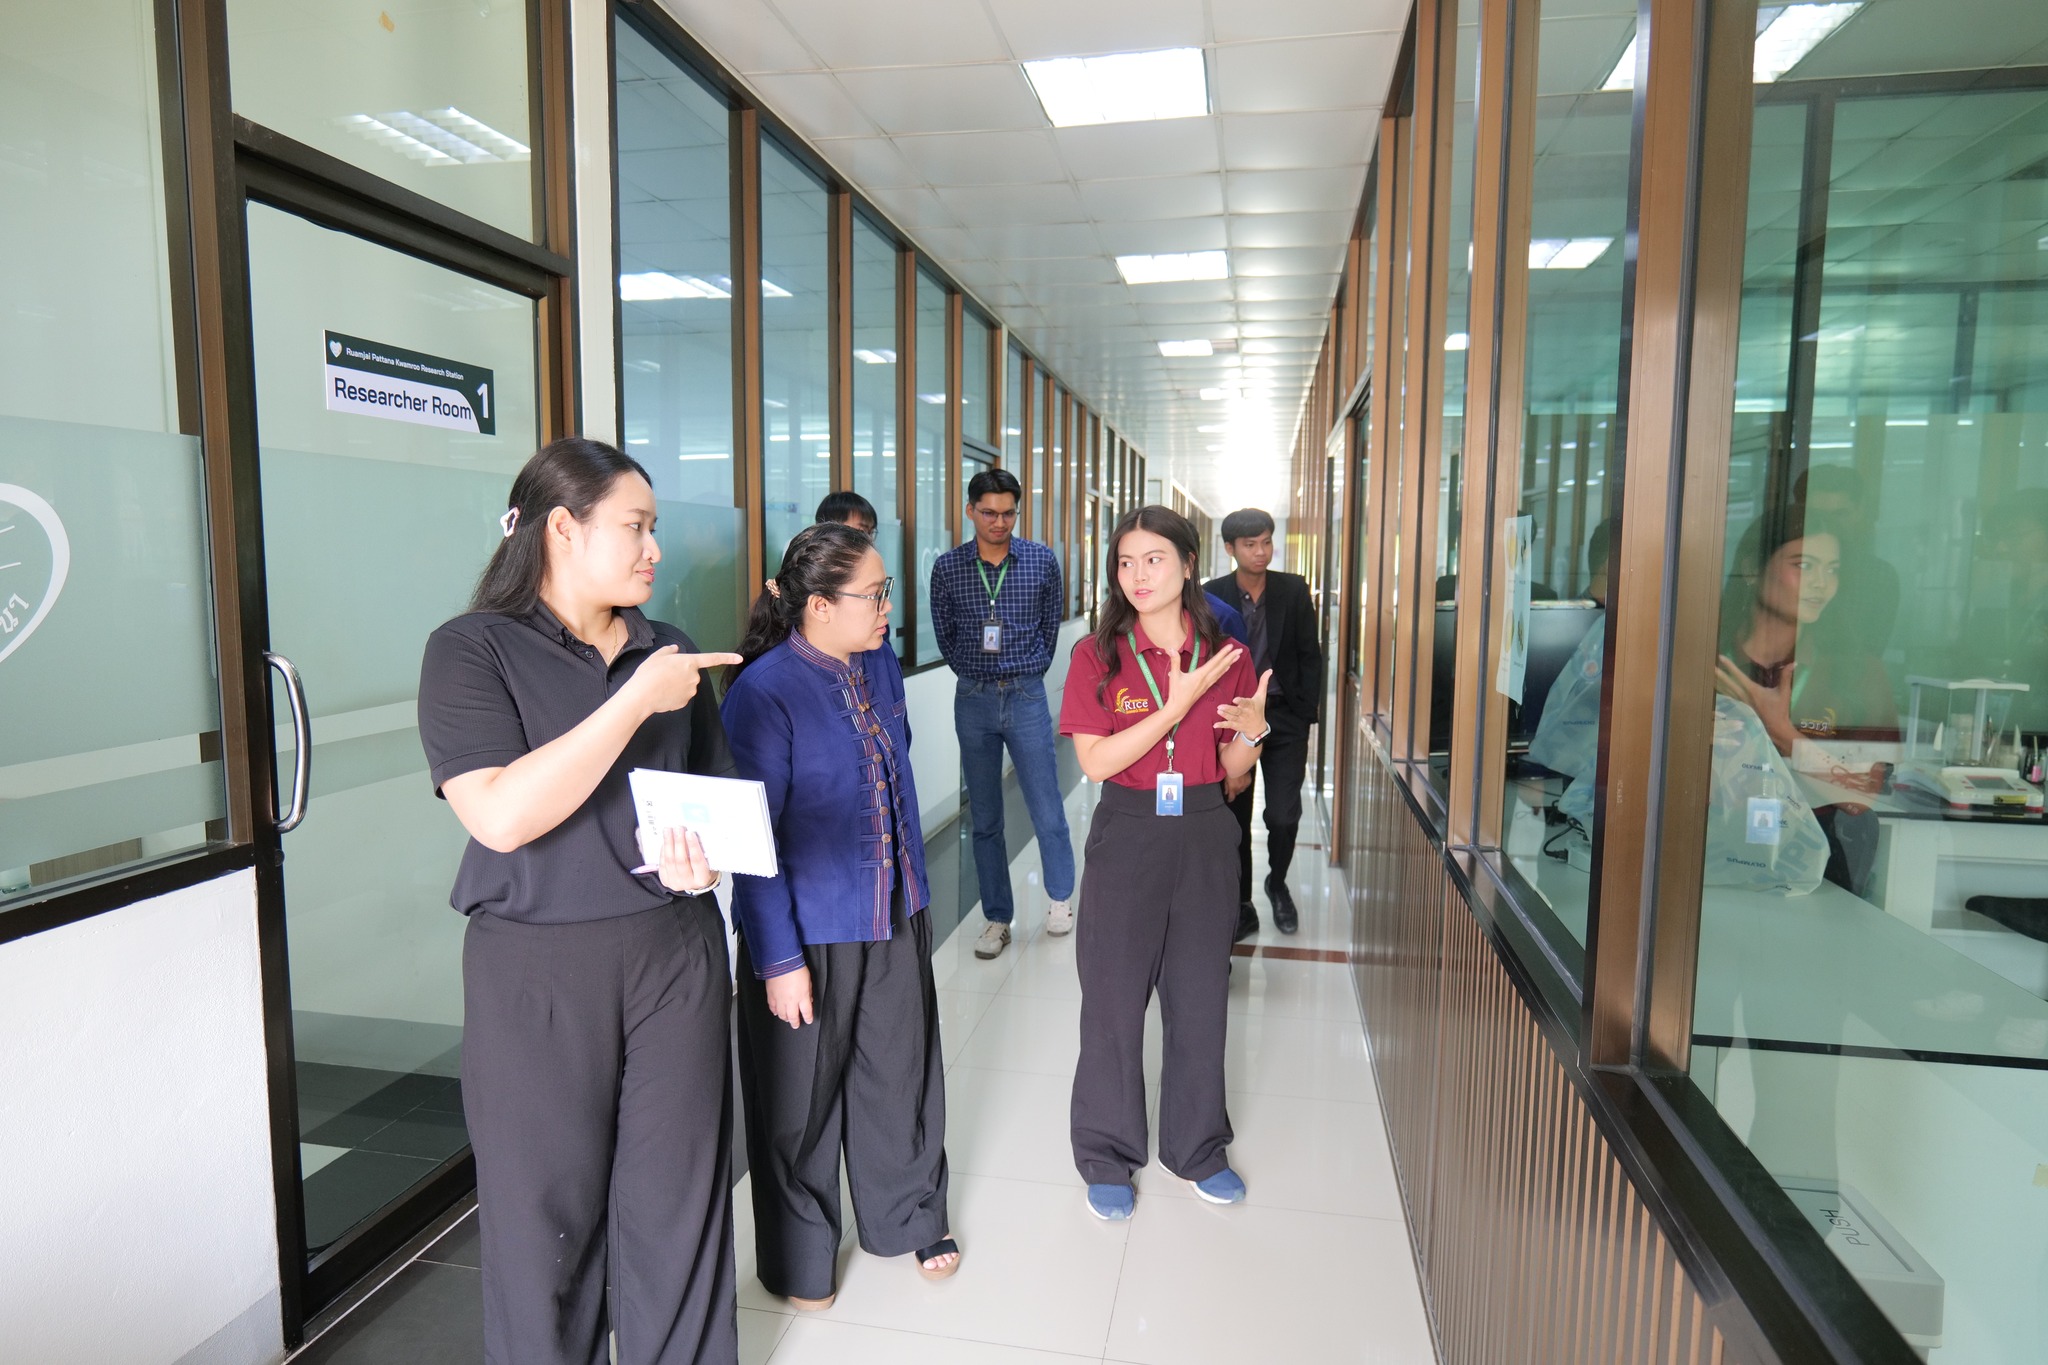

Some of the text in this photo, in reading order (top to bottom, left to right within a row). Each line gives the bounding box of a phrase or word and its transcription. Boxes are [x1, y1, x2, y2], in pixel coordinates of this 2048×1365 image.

[346, 347, 371, 361] Ruamjai
[372, 353, 395, 366] Pattana
[421, 364, 445, 376] Research
[446, 369, 464, 381] Station
[334, 377, 472, 420] Researcher Room
[476, 382, 489, 419] 1
[1819, 1208, 1870, 1246] PUSH
